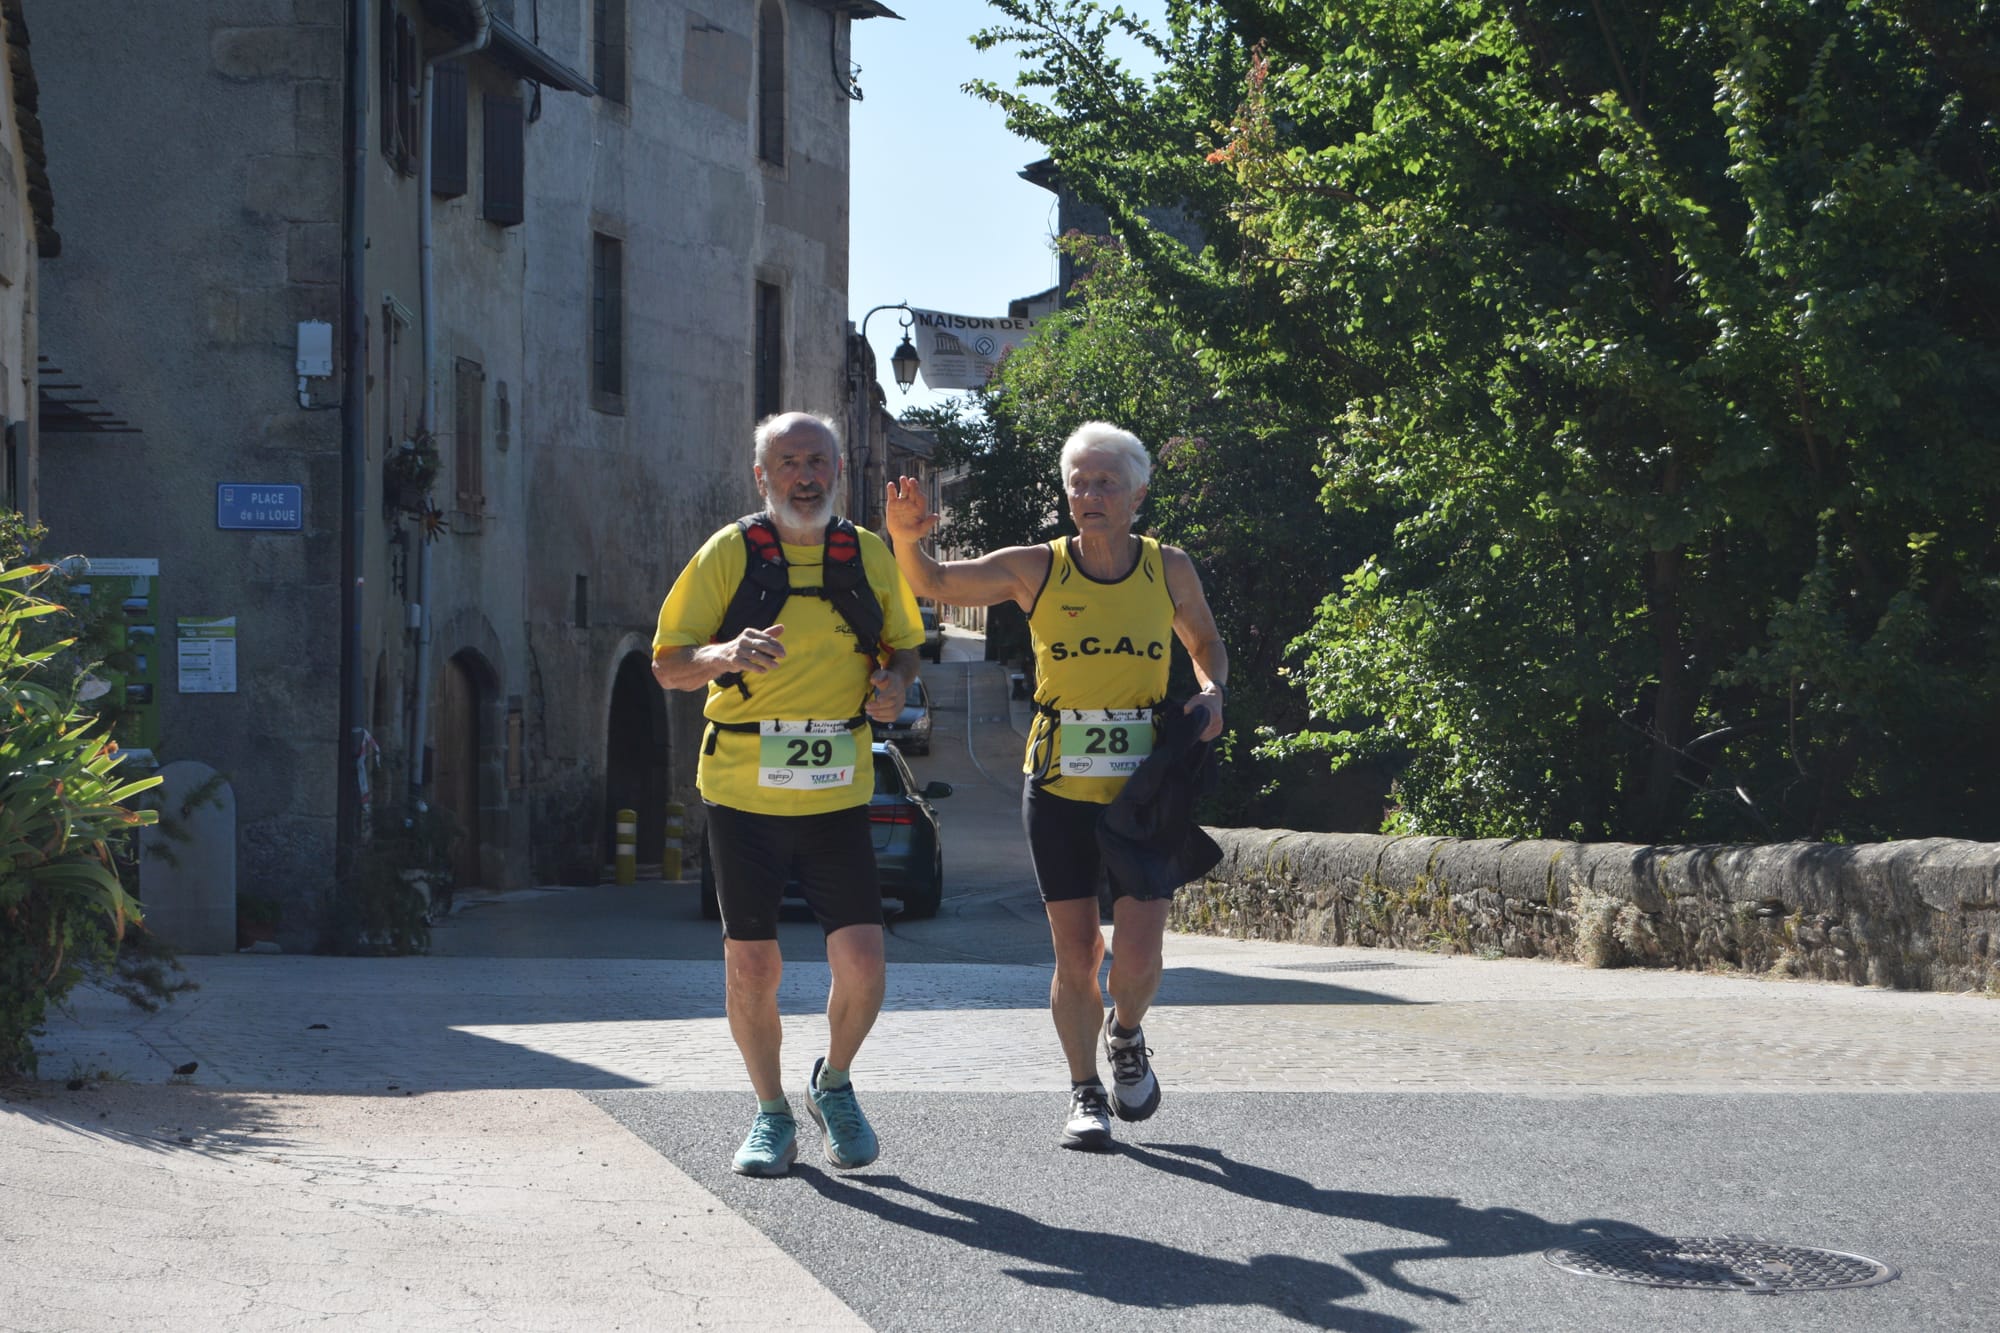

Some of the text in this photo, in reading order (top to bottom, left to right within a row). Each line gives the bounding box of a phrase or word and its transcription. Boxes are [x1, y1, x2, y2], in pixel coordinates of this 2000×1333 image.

[918, 313, 995, 329] MAISON
[1001, 319, 1025, 330] DE
[251, 493, 285, 504] PLACE
[240, 509, 253, 521] de
[269, 509, 296, 521] LOUE
[1085, 727, 1130, 755] 28
[786, 739, 833, 767] 29
